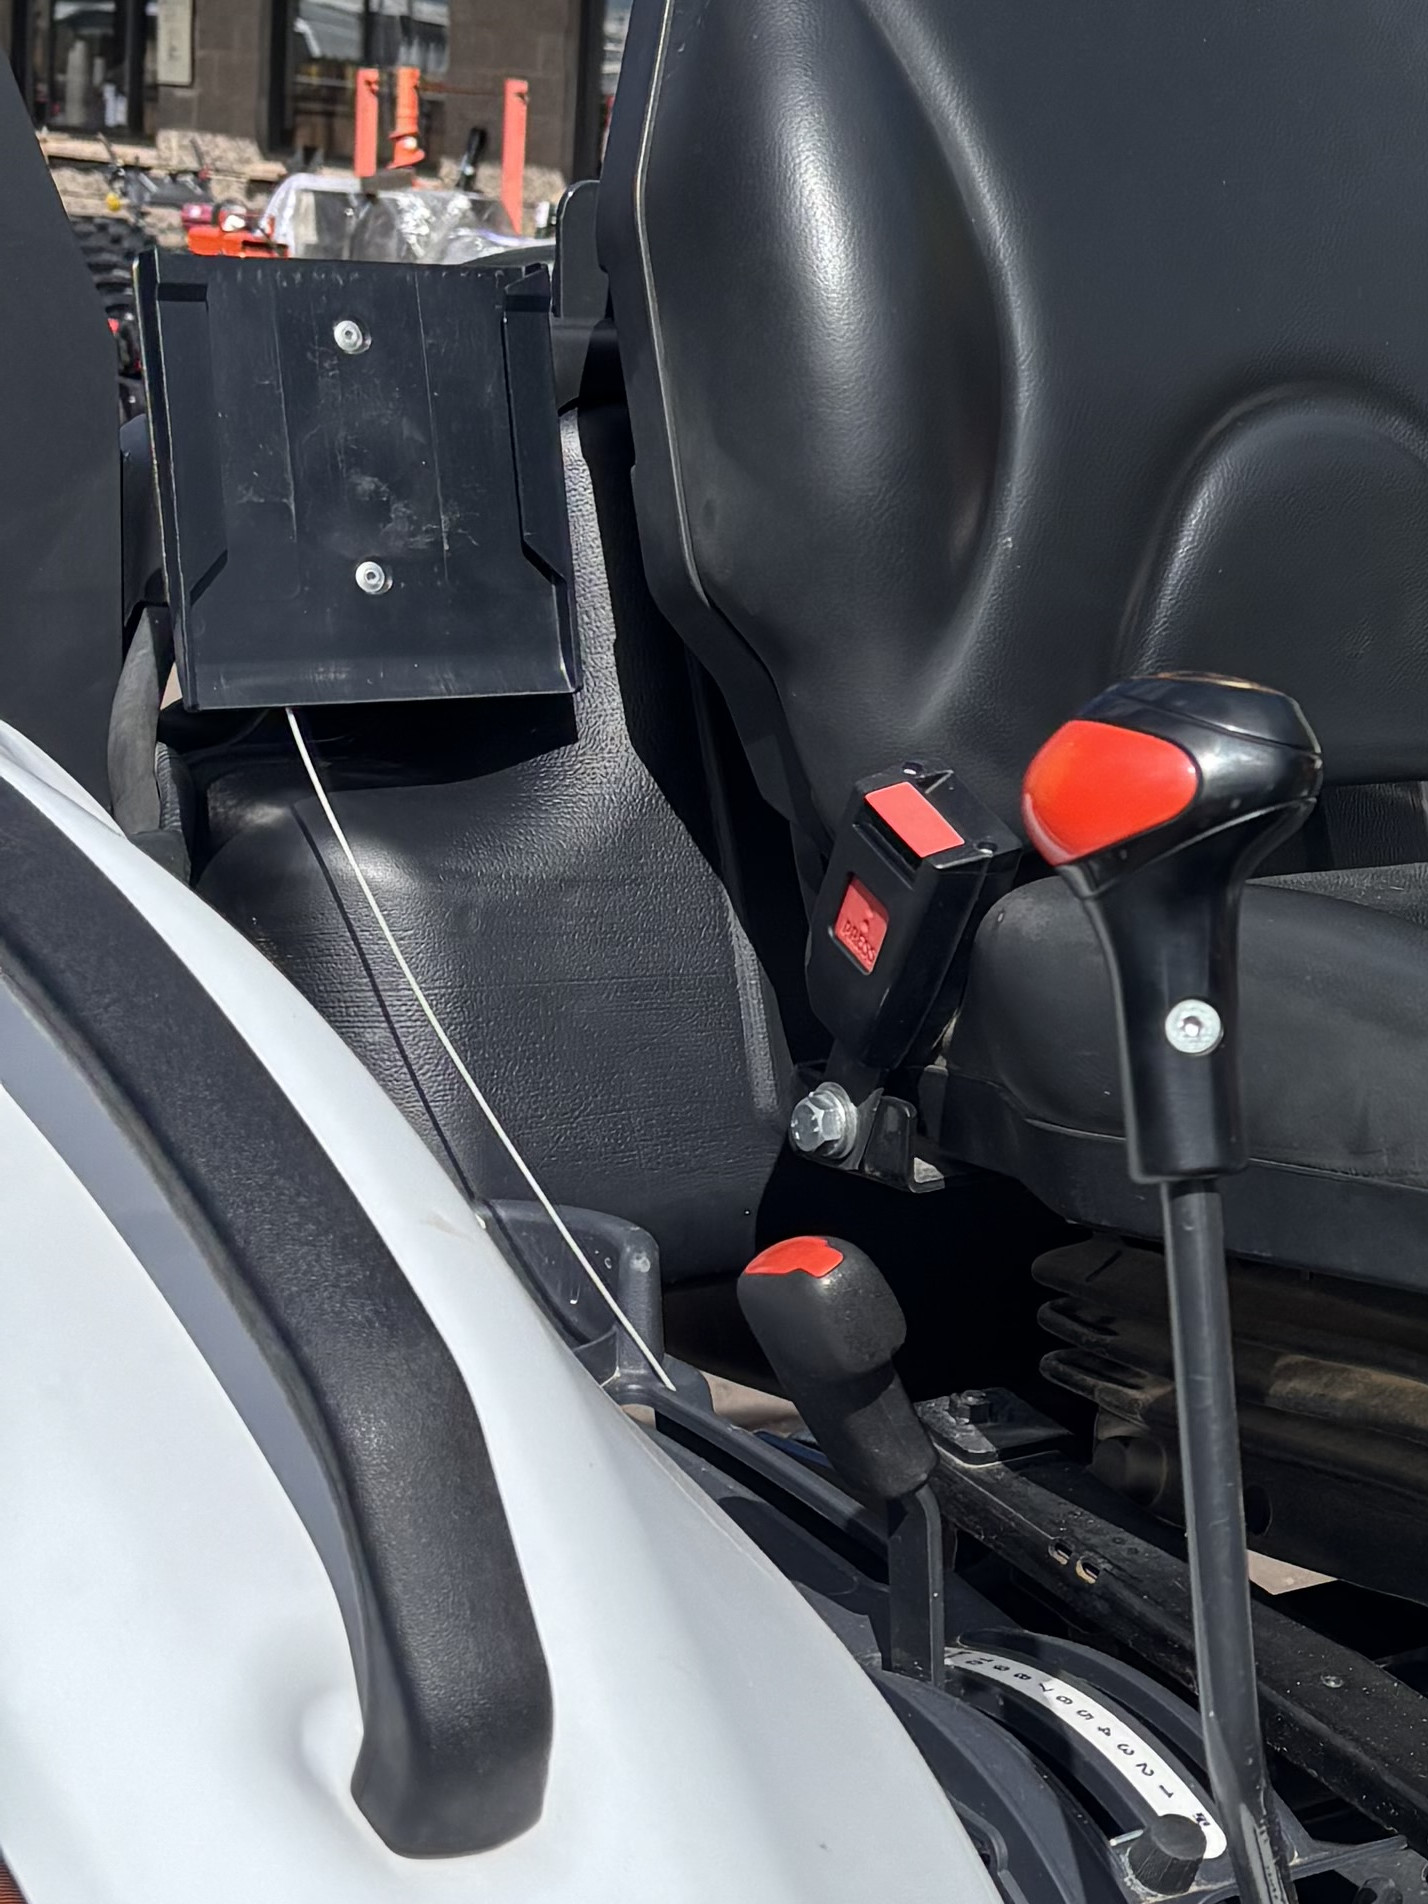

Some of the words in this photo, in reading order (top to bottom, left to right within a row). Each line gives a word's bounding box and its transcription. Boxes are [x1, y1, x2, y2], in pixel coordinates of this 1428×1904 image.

[1077, 1709, 1094, 1721] 5
[1097, 1725, 1112, 1737] 4
[1117, 1743, 1135, 1756] 3
[1136, 1762, 1155, 1777] 2
